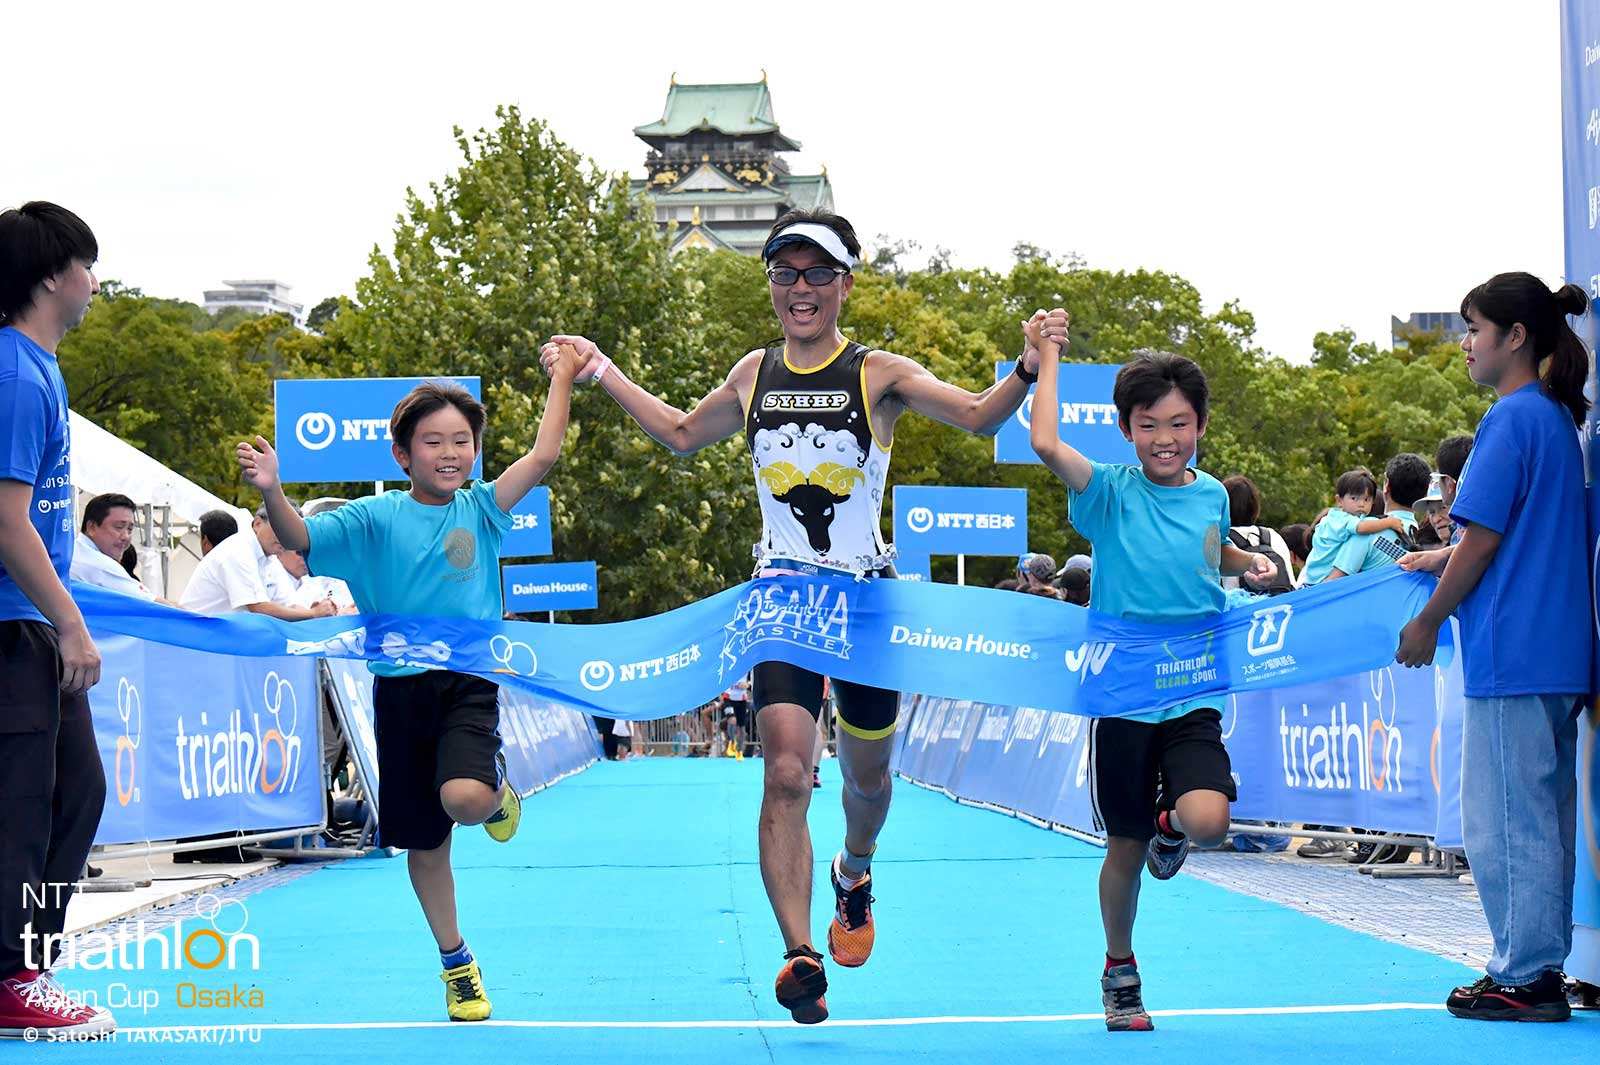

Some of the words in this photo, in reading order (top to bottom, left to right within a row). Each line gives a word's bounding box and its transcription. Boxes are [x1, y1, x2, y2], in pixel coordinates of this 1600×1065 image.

[1061, 402, 1117, 425] NTT
[937, 512, 974, 529] NTT
[976, 513, 1016, 530] 西日本
[512, 583, 550, 595] Daiwa
[551, 582, 588, 593] House
[743, 583, 849, 640] OSAKA
[747, 626, 835, 650] CASTLE
[889, 625, 962, 651] Daiwa
[965, 633, 1032, 659] House
[619, 657, 664, 682] NTT
[665, 643, 702, 673] 西日本
[1155, 655, 1207, 676] TRIATHLON
[1155, 674, 1189, 690] CLEAN
[1191, 668, 1217, 685] SPORT
[175, 710, 302, 801] triathlon
[1280, 702, 1403, 793] triathlon
[1500, 986, 1516, 994] FILA
